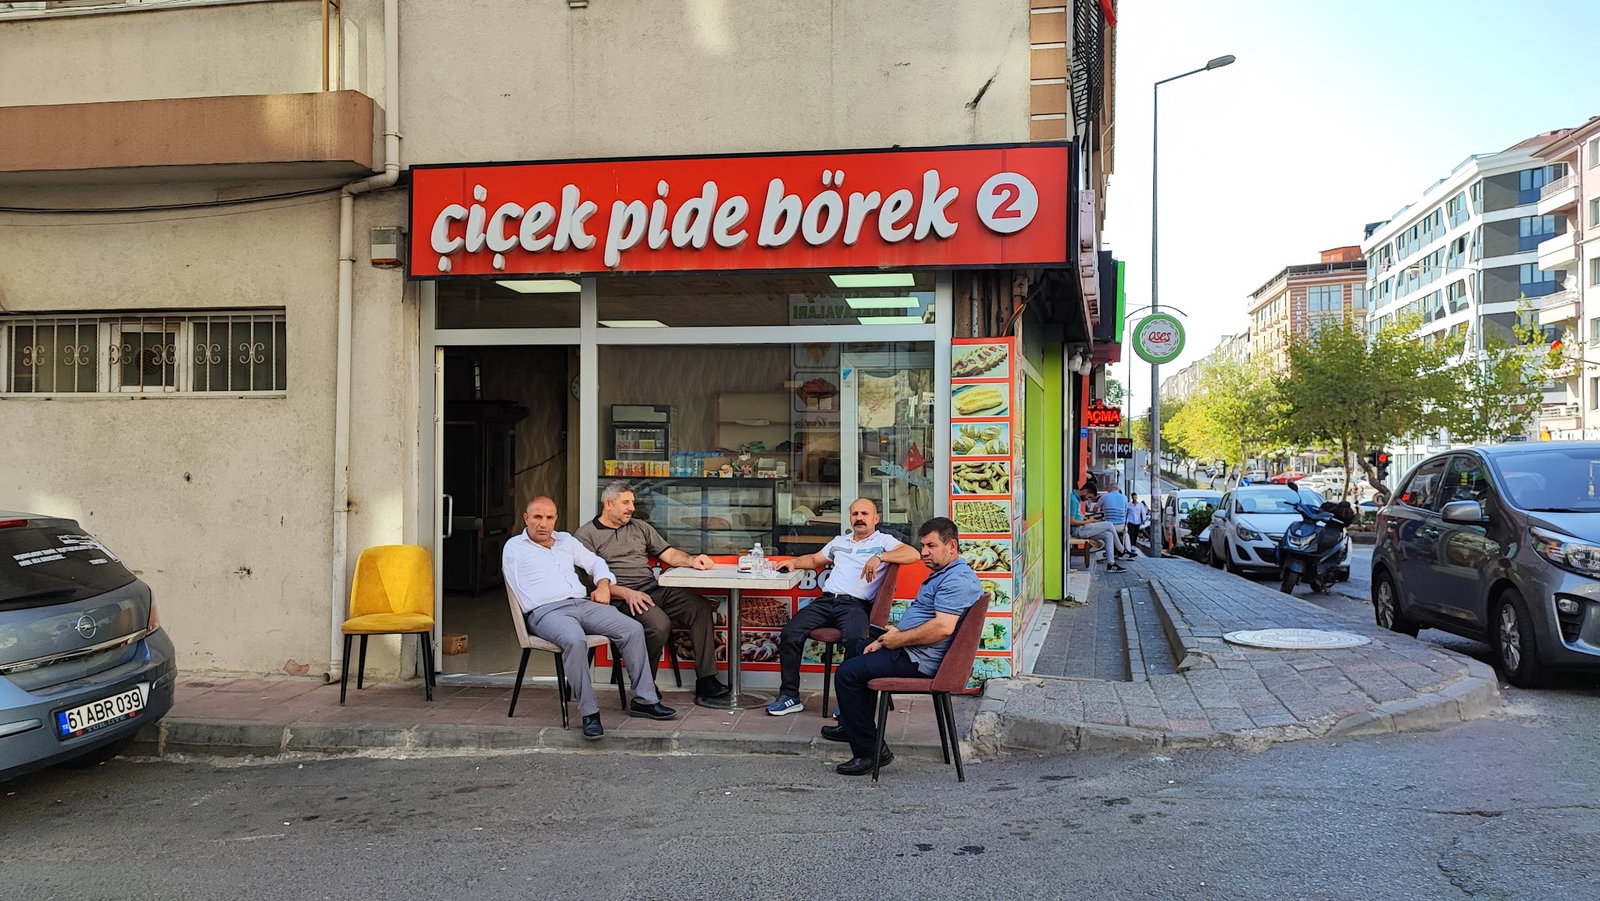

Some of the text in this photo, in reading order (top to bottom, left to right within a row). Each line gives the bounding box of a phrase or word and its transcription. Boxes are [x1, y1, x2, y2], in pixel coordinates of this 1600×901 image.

[430, 168, 1022, 273] çiçek pide börek 2
[68, 709, 83, 730] 61
[87, 700, 115, 725] ABR
[116, 691, 141, 714] 039
